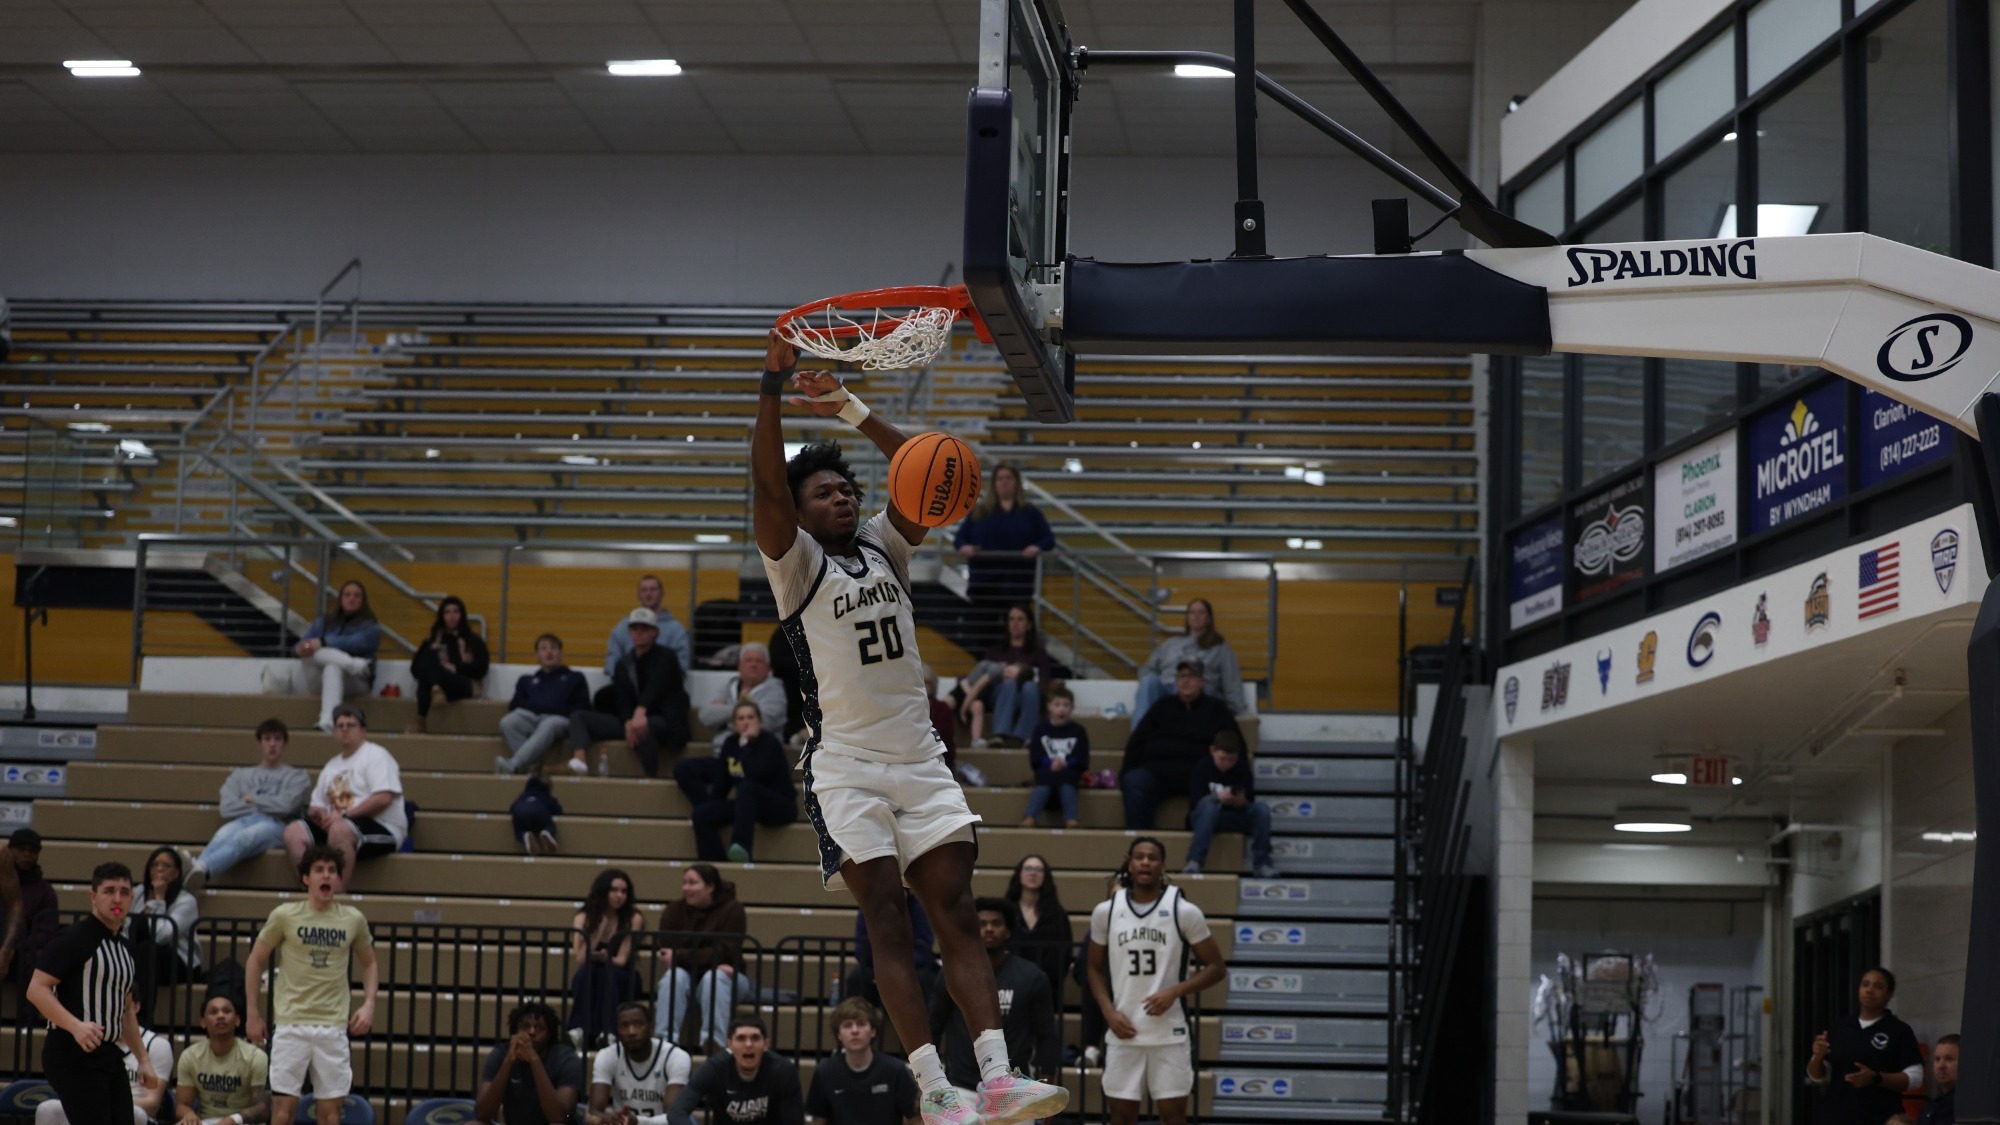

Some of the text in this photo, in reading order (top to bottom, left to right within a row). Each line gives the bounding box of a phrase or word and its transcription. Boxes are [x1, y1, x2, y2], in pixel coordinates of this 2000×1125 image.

[1567, 239, 1757, 288] SPALDING
[1873, 403, 1907, 431] Clarion,
[1879, 424, 1941, 471] (814) 227-2223
[1681, 453, 1722, 485] Phoenix
[1757, 428, 1845, 500] MICROTEL
[927, 456, 957, 517] Wilson
[1684, 493, 1717, 519] CLARION
[1769, 483, 1832, 527] BY WYNDHAM
[833, 581, 902, 620] CLARION
[854, 615, 904, 666] 20
[1692, 756, 1728, 785] EXIT
[297, 926, 347, 942] CLARION
[1117, 926, 1167, 947] CLARION
[1127, 949, 1157, 976] 33
[197, 1072, 242, 1087] CLARION
[619, 1088, 664, 1103] CLARION
